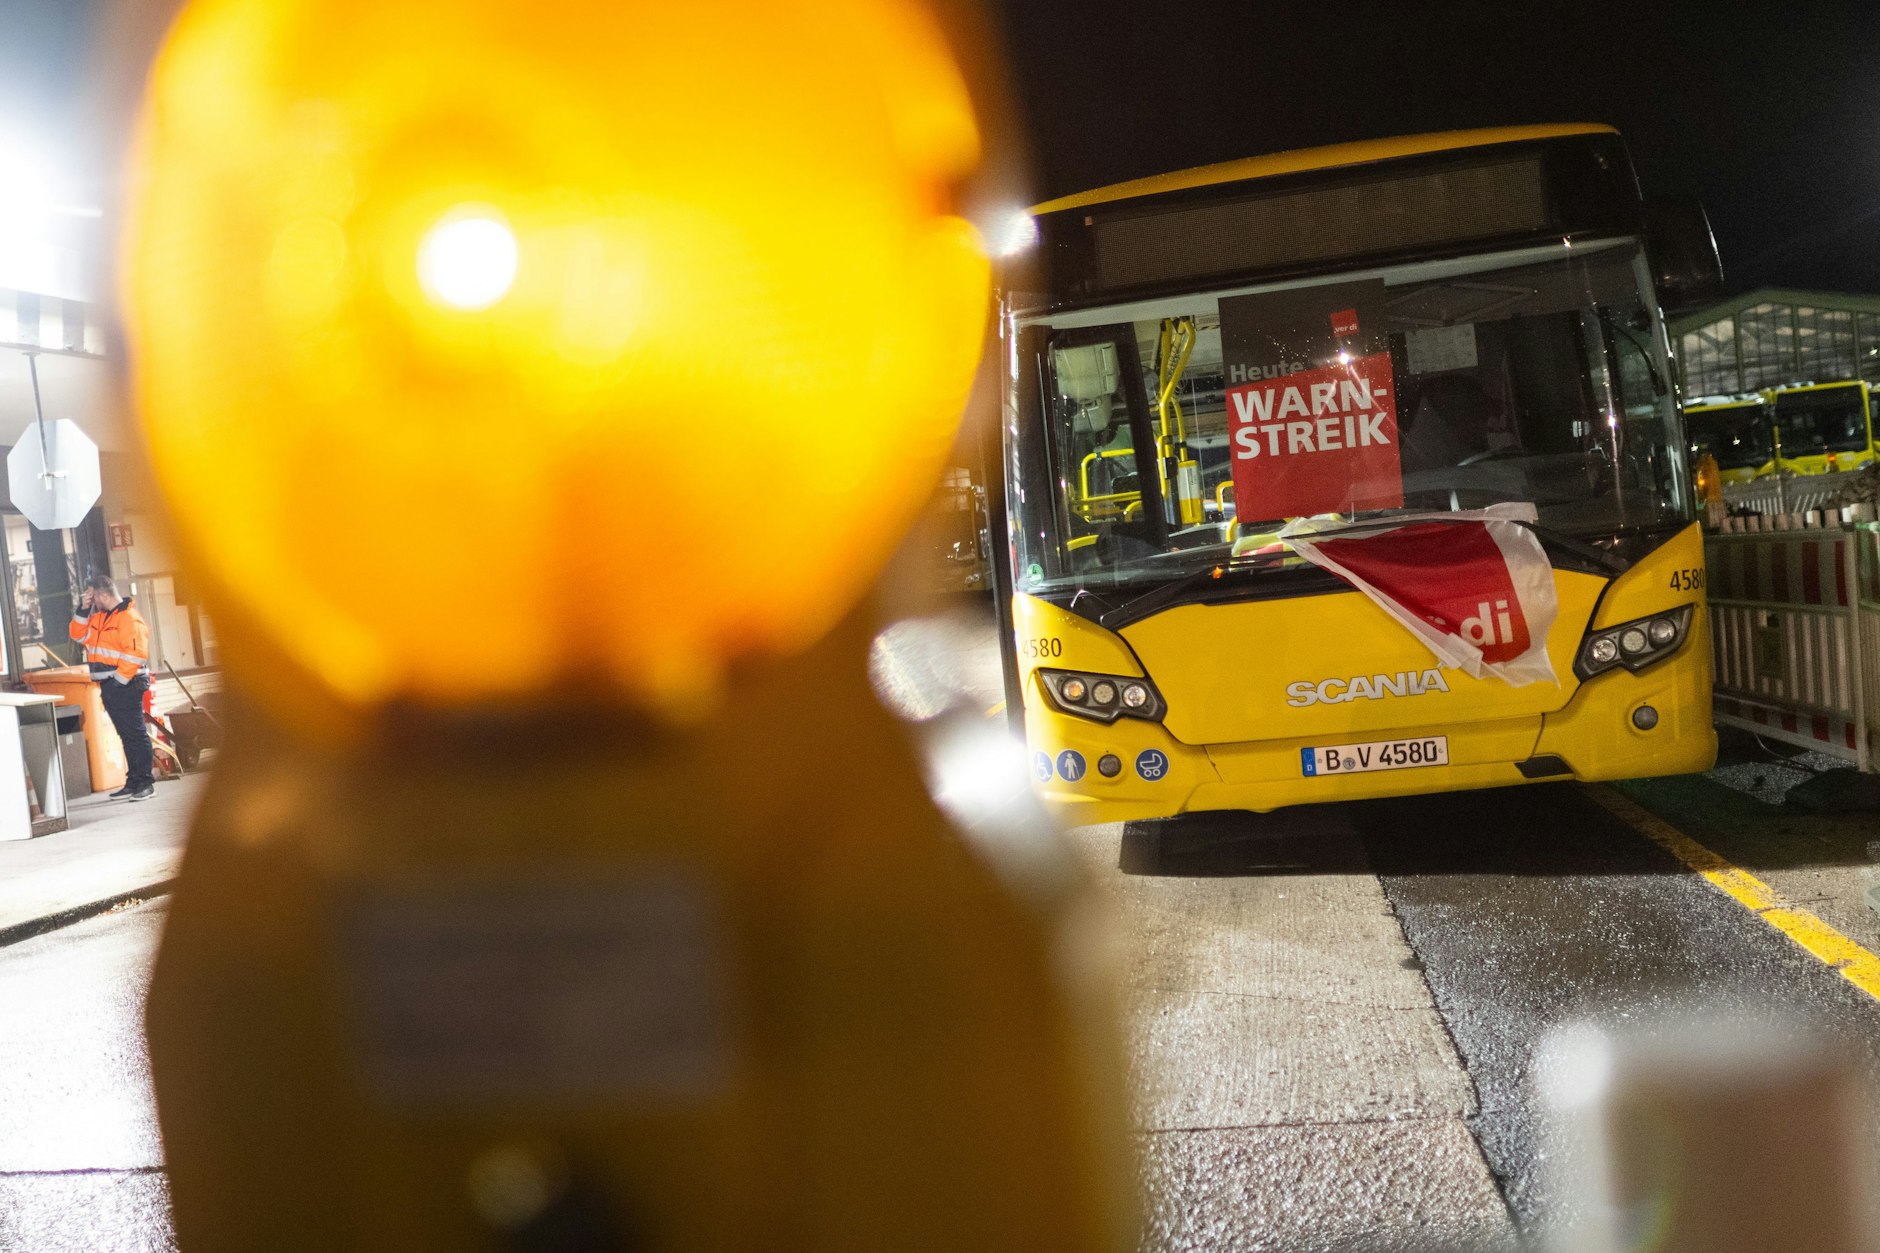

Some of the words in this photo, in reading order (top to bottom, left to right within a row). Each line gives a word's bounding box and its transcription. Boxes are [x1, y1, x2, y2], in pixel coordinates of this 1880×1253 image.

[1229, 360, 1304, 383] Heute
[1232, 378, 1388, 423] WARN-
[1235, 412, 1391, 460] STREIK
[1669, 567, 1705, 591] 4580
[1023, 637, 1062, 658] 4580
[1286, 668, 1450, 707] SCANIA
[1325, 749, 1341, 771] B
[1357, 746, 1372, 768] V
[1379, 740, 1438, 766] 4580
